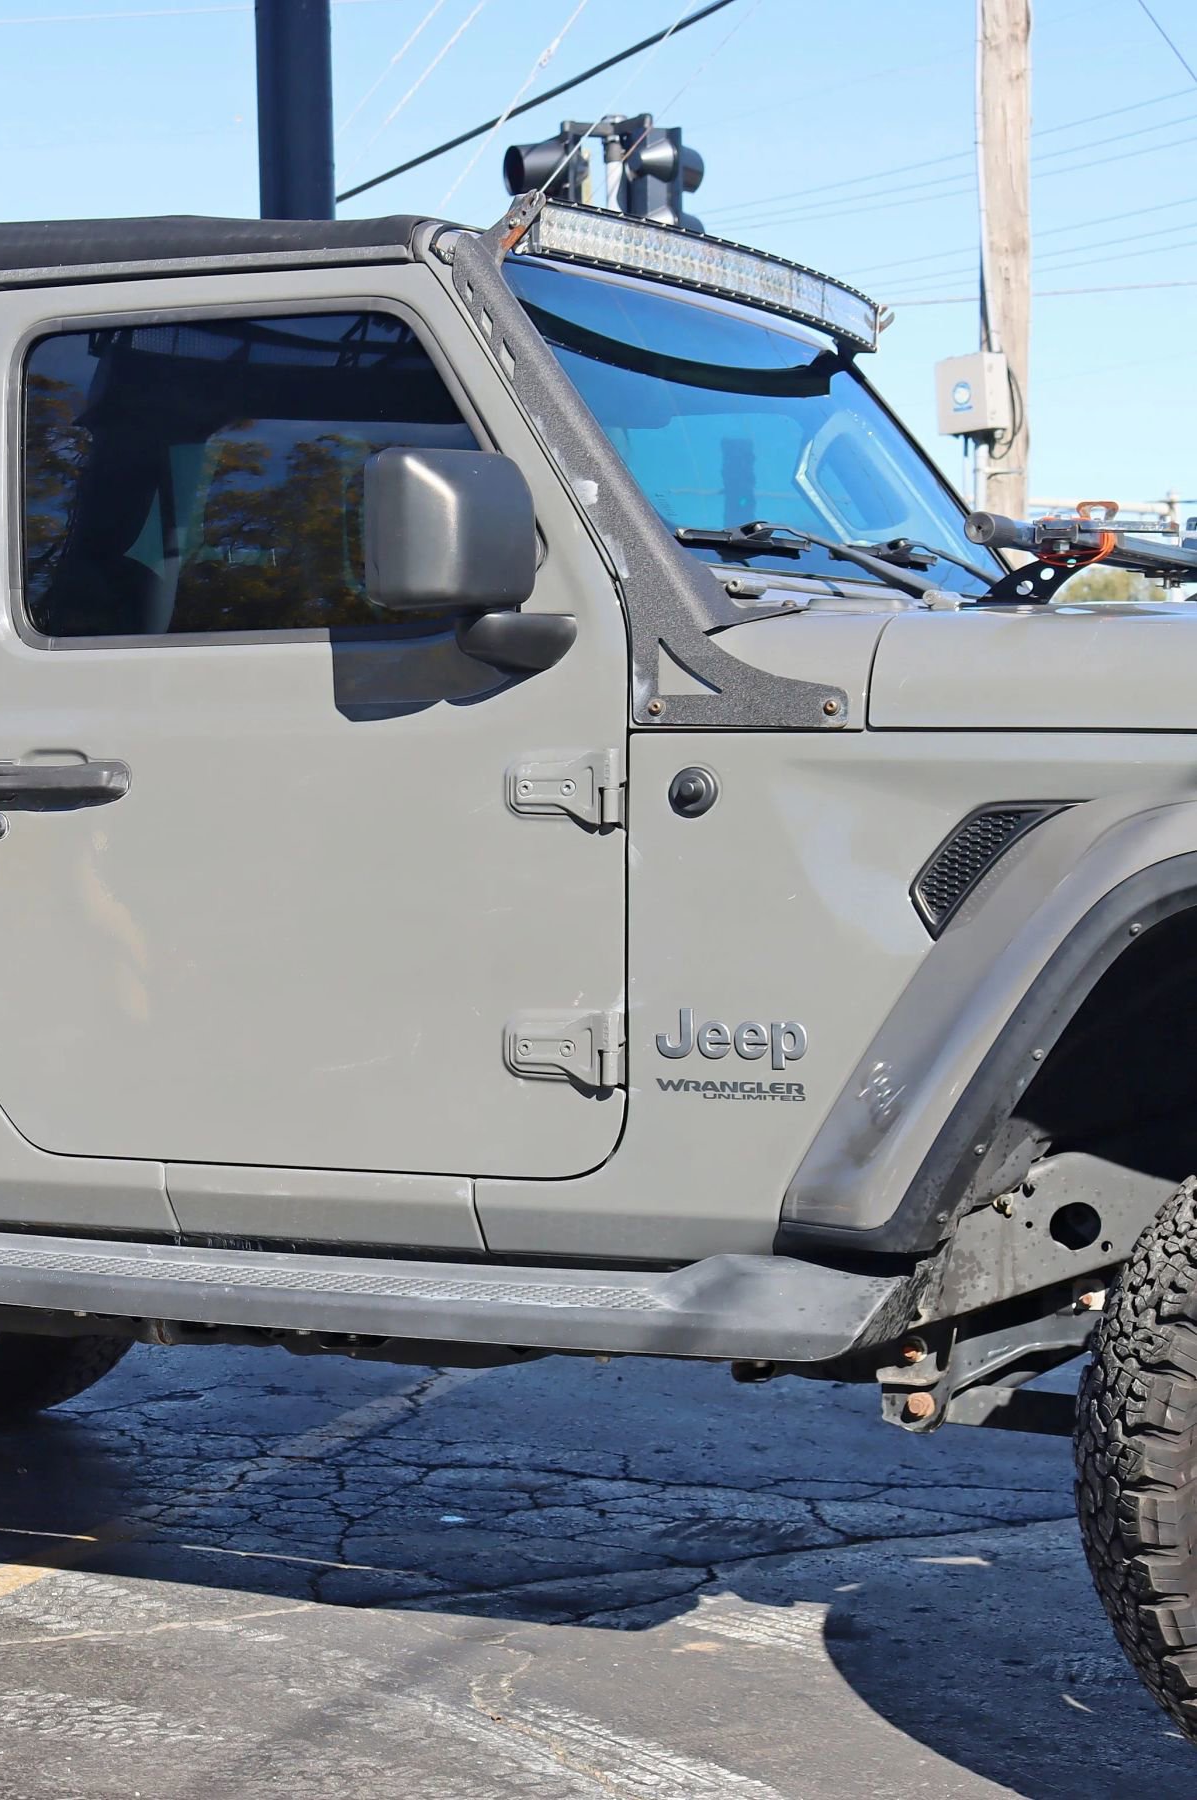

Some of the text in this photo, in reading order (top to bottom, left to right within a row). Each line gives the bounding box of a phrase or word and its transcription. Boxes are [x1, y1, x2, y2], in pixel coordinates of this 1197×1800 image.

[655, 1007, 808, 1070] Jeep
[656, 1078, 805, 1095] WRANGLER
[702, 1092, 806, 1102] UNLIMITED
